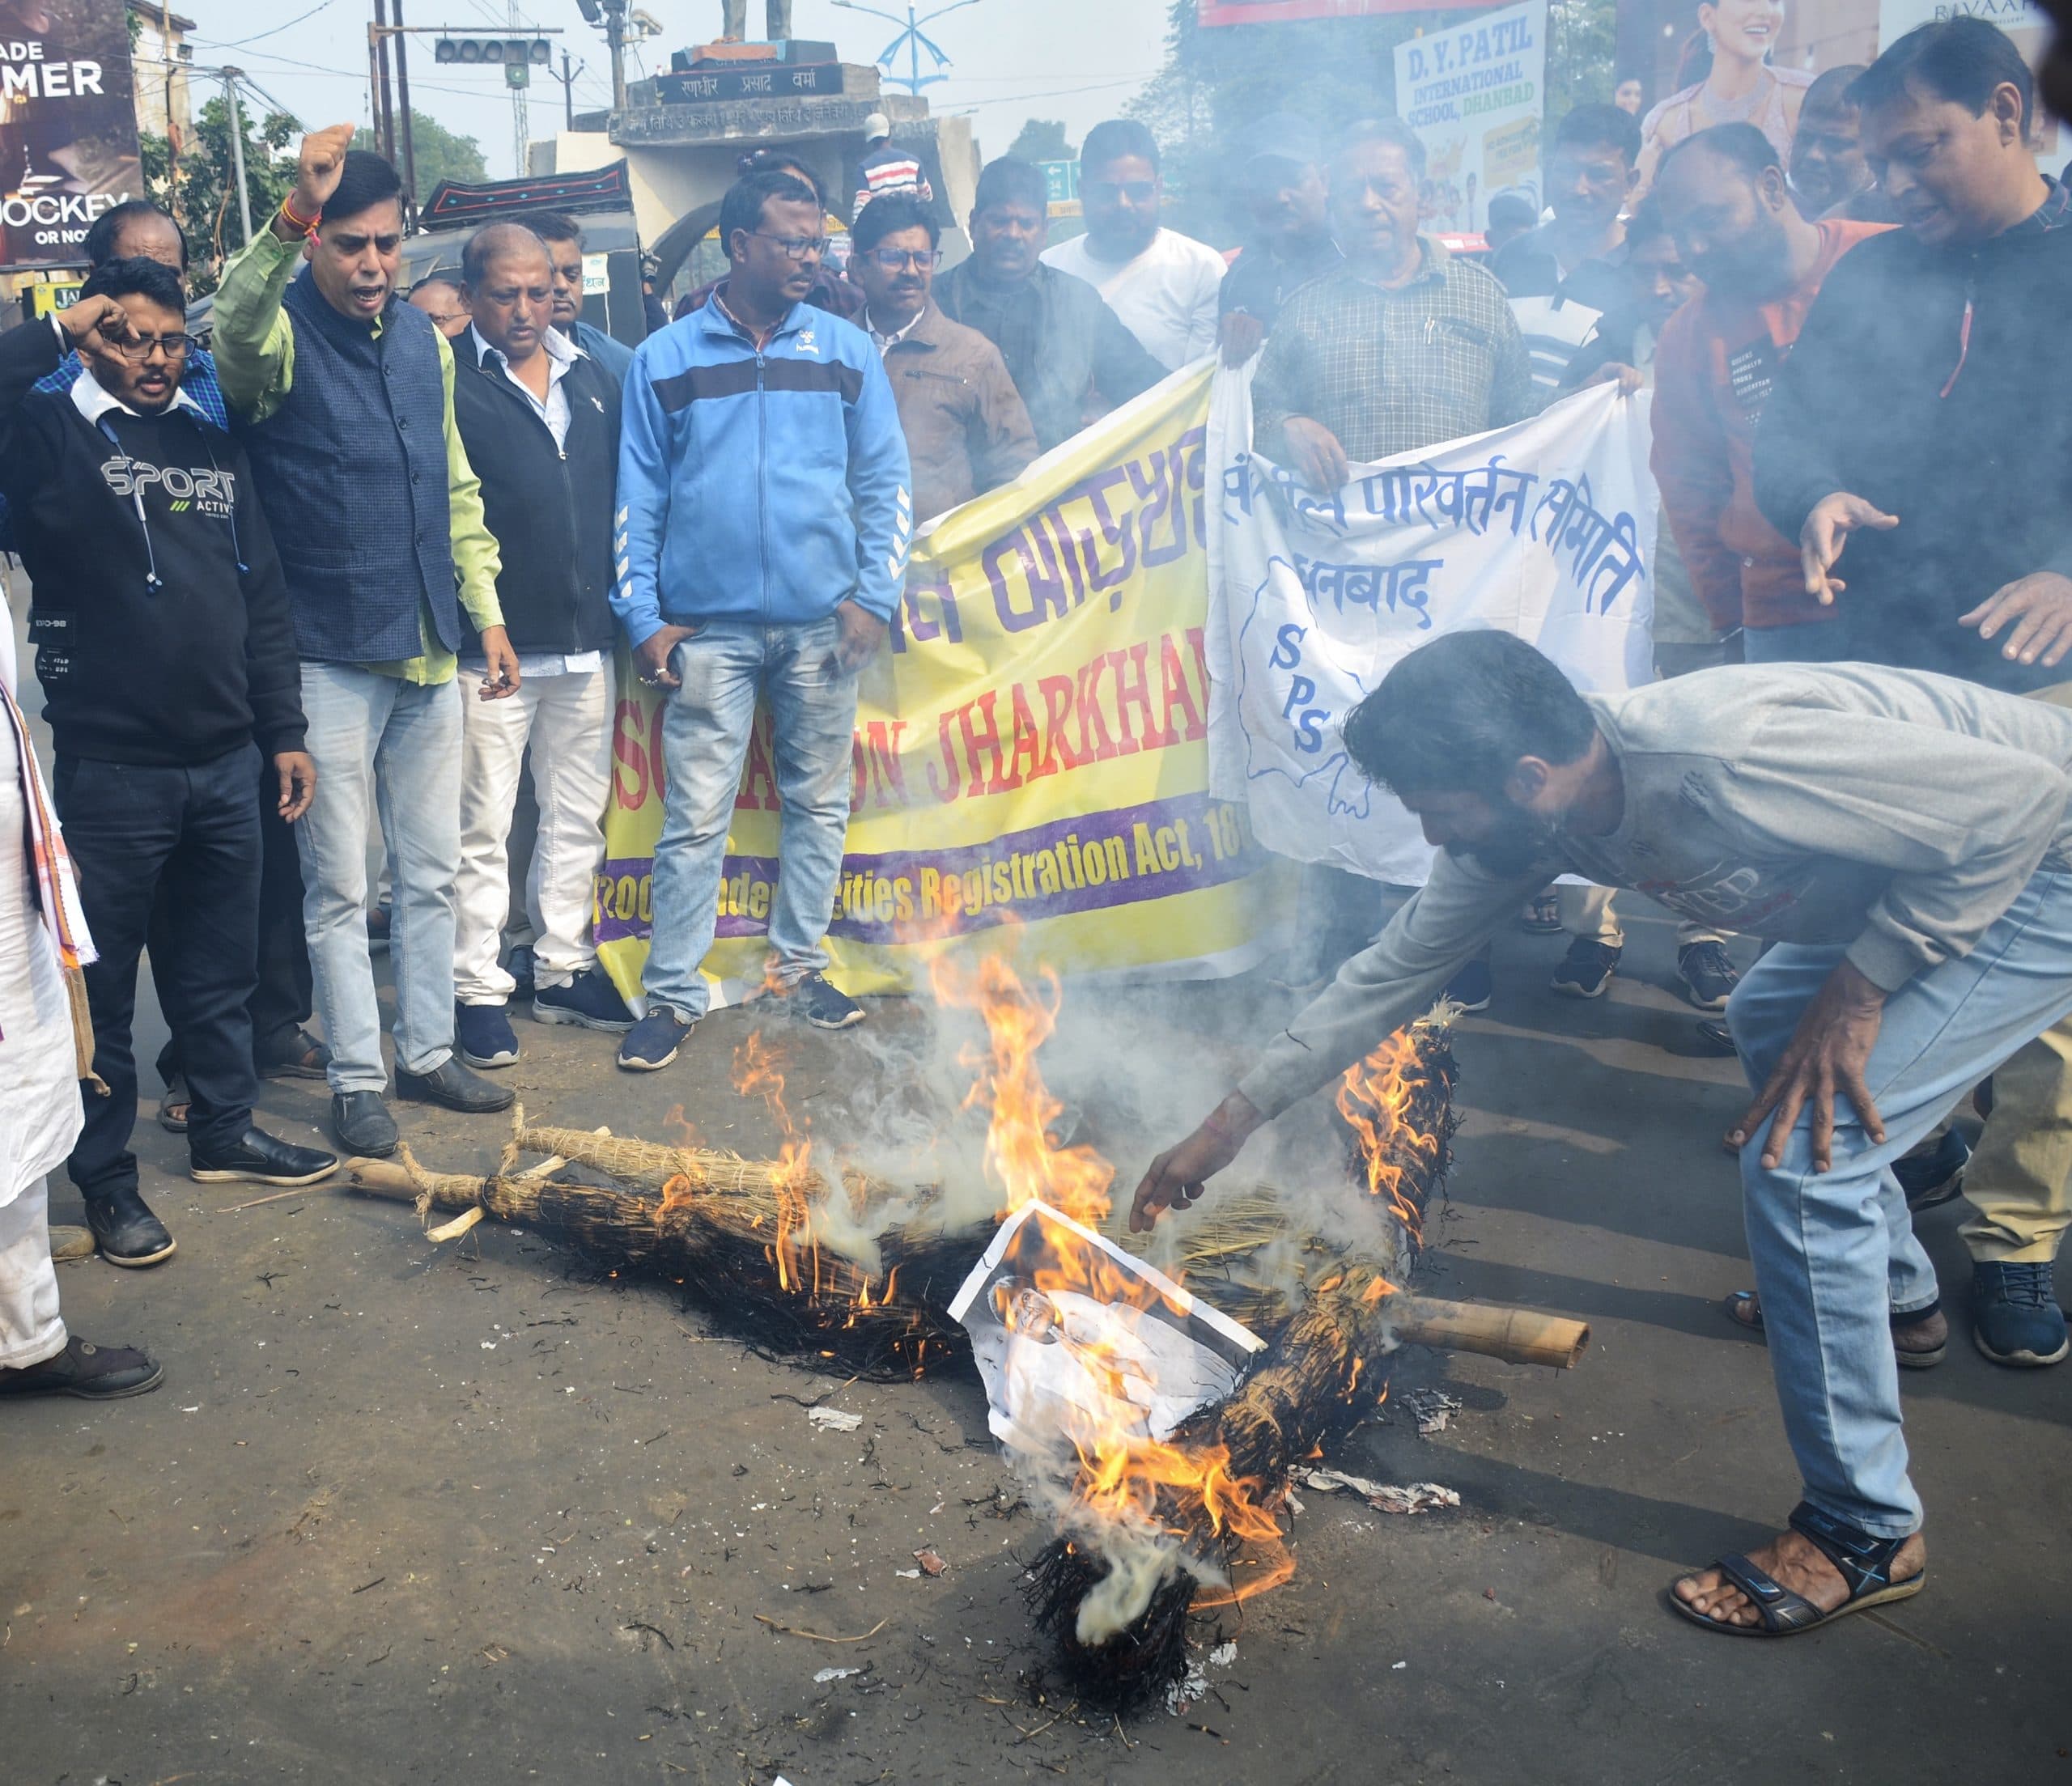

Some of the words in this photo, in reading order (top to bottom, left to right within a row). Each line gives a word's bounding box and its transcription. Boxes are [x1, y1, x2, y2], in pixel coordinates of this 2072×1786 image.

[1459, 15, 1533, 67] PATIL
[2, 61, 104, 99] MER
[681, 76, 719, 98] रणधीर
[792, 69, 816, 89] वर्मा
[1414, 61, 1523, 106] INTERNATIONAL
[1408, 102, 1461, 128] SCHOOL,
[1463, 82, 1535, 117] DHANBAD
[35, 230, 59, 245] OR
[62, 229, 90, 244] NO
[100, 461, 236, 503] SPORT
[197, 501, 234, 514] ACTIV
[920, 834, 1130, 919] Registration
[1133, 821, 1203, 876] Act,
